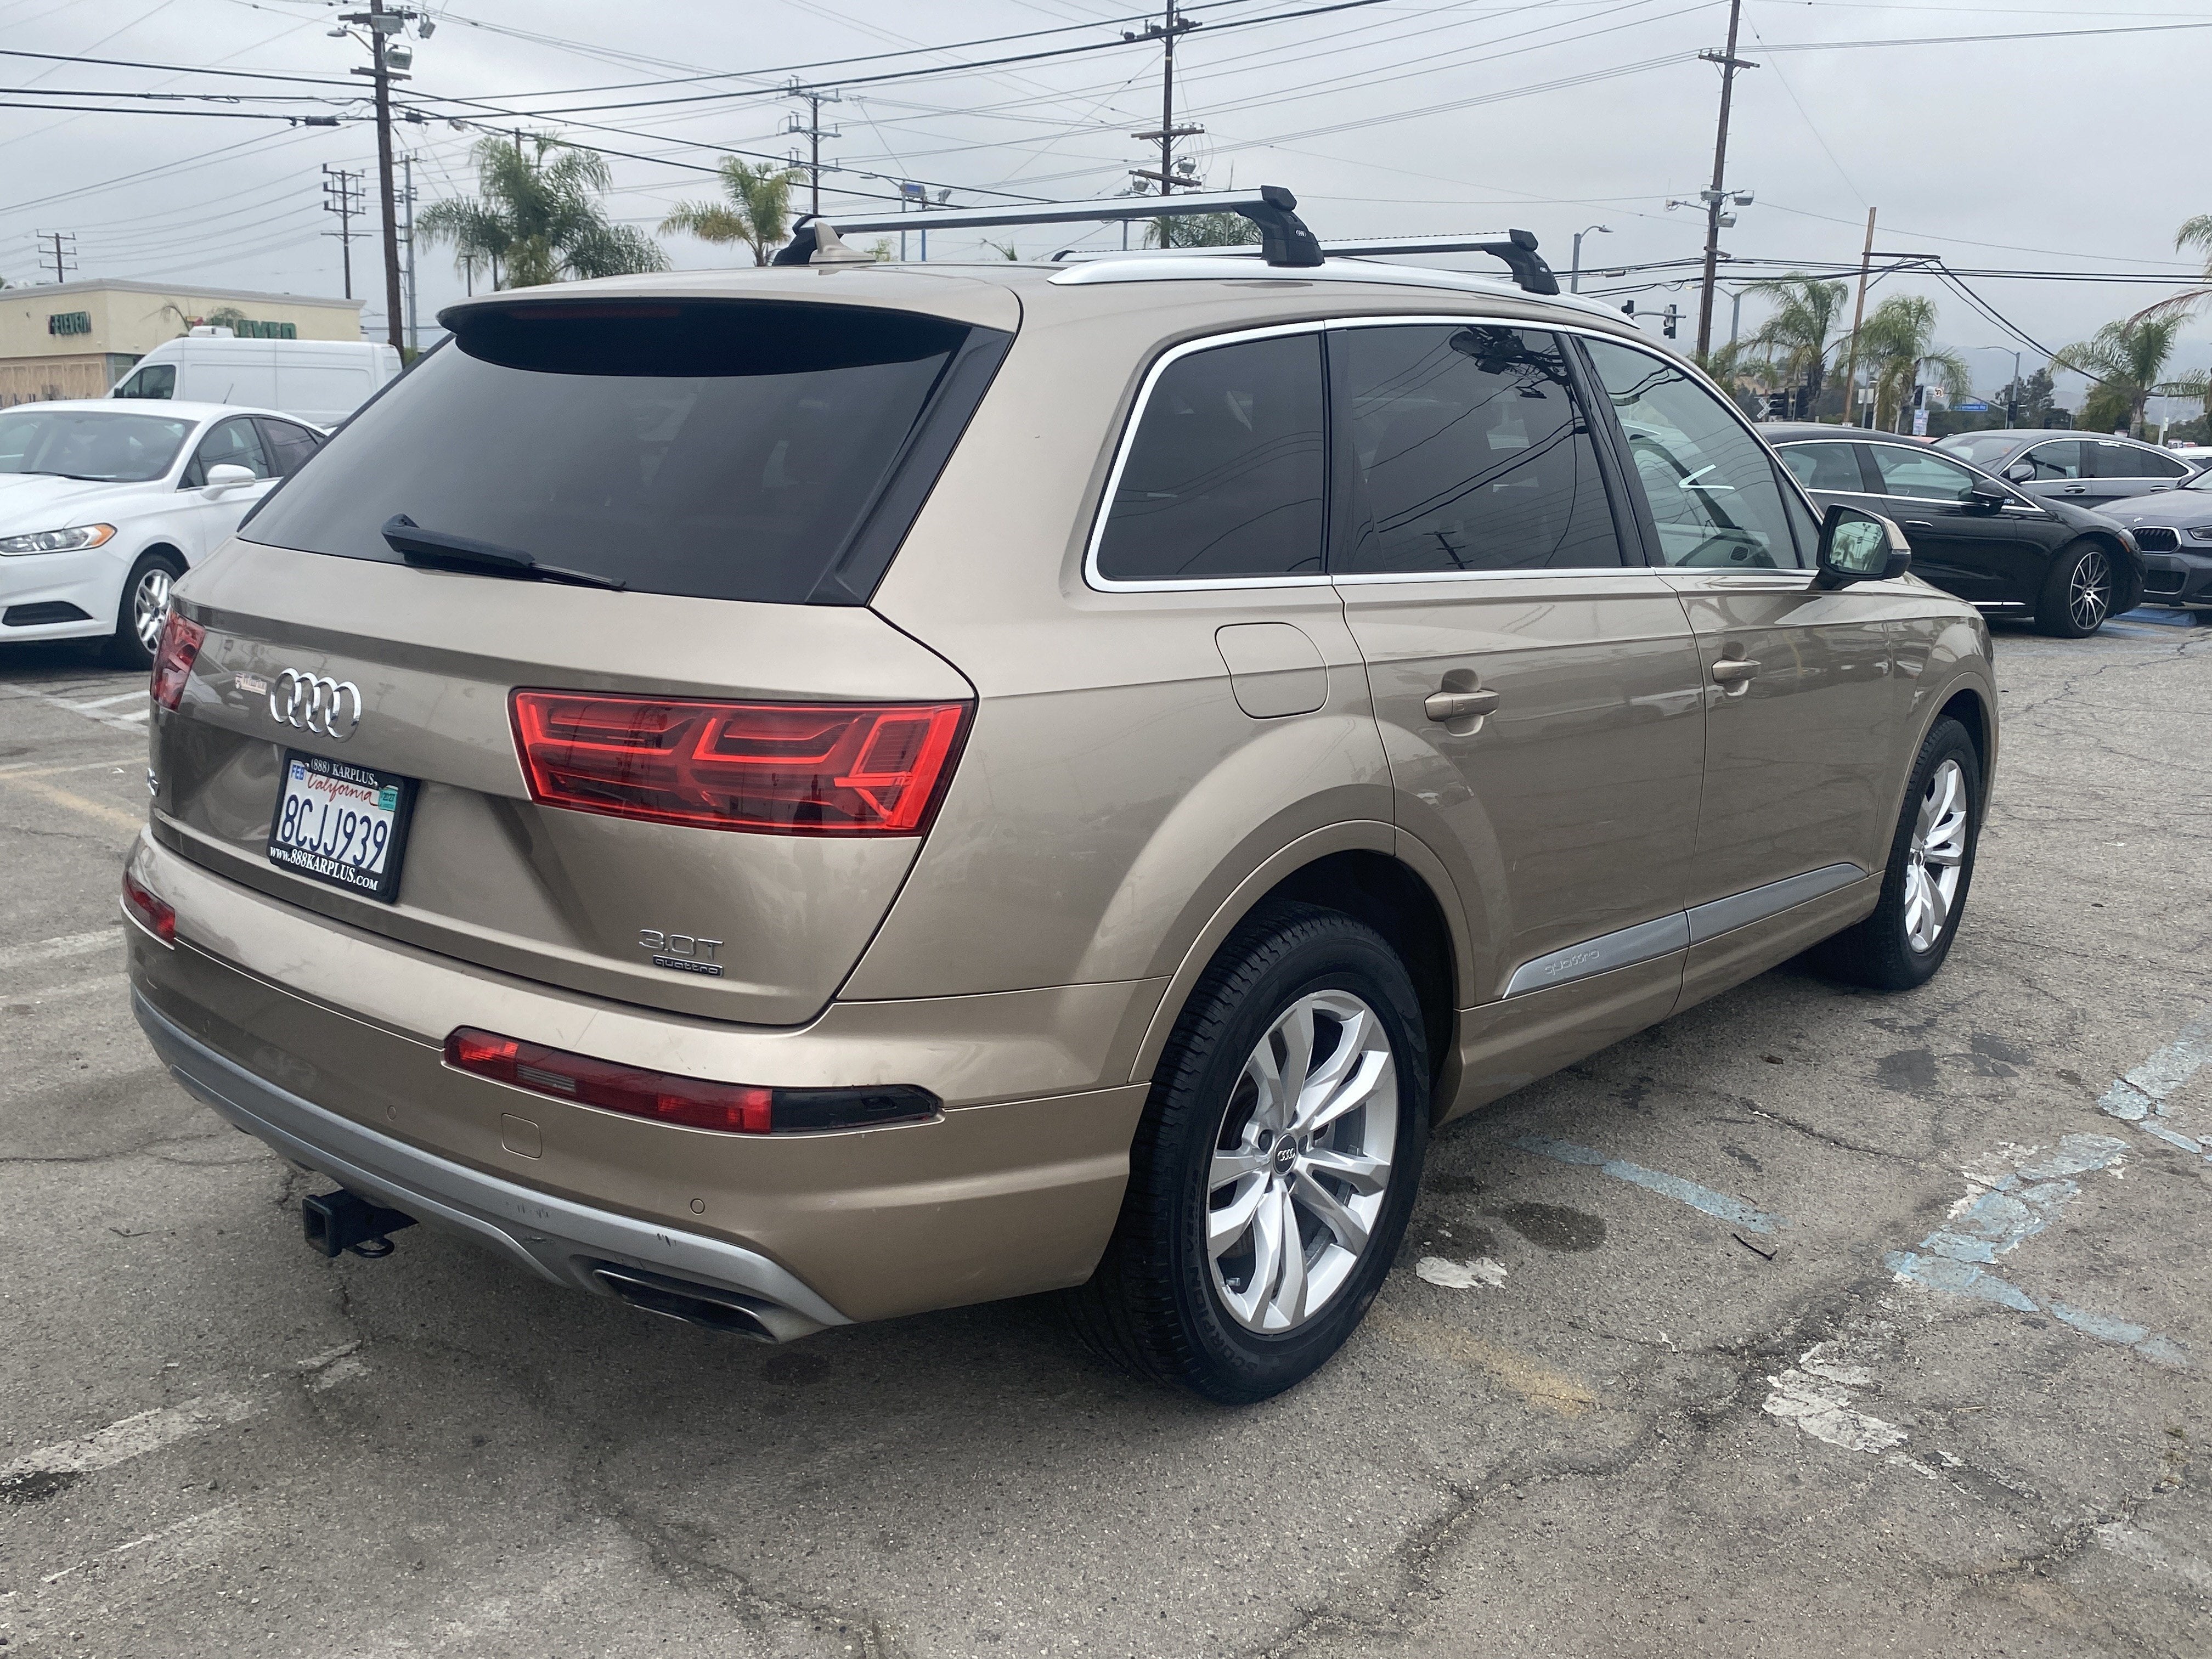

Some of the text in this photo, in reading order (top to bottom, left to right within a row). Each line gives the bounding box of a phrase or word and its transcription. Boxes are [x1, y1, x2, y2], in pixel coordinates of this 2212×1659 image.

[291, 764, 305, 781] FEB
[311, 758, 375, 786] (888) KARPLUS
[308, 774, 379, 806] California
[281, 794, 387, 870] 8CJJ939
[270, 847, 379, 891] www.888KARPLUS.COM
[639, 929, 724, 960] 3.0T
[654, 958, 719, 975] quattro
[1544, 949, 1600, 975] quattro
